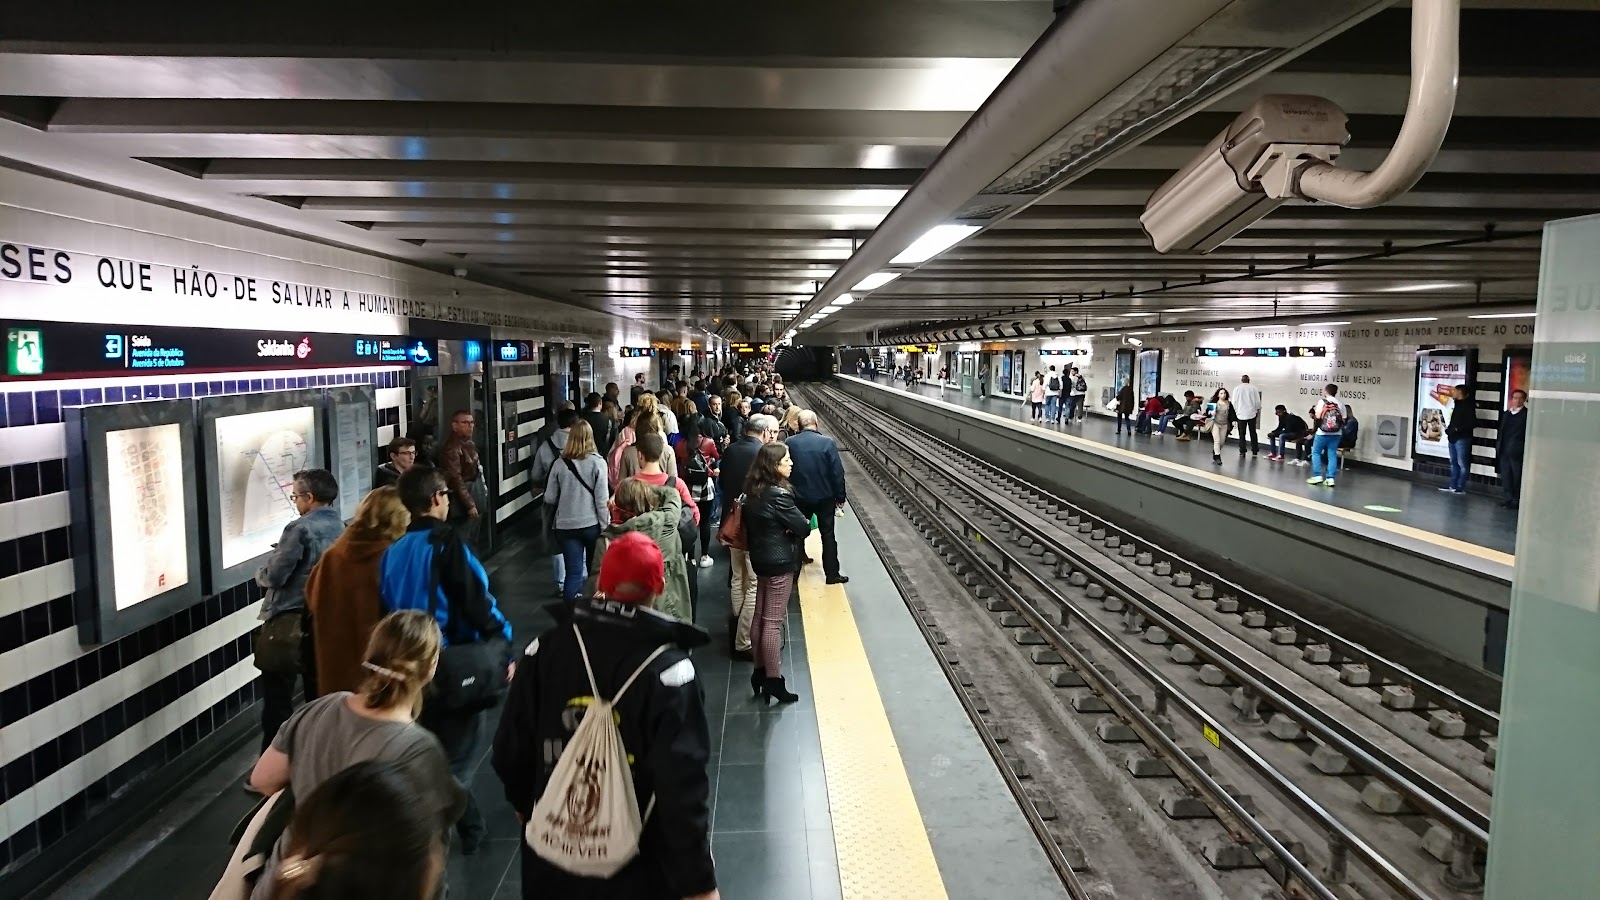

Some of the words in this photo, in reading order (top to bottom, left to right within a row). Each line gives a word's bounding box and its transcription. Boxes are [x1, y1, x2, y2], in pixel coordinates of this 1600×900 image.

[0, 243, 72, 284] SES
[97, 257, 153, 292] QUE
[173, 264, 257, 301] HÃO-DE
[271, 281, 332, 309] SALVAR
[342, 291, 351, 311] A
[359, 293, 426, 317] HUMANIDADE
[1322, 330, 1335, 338] NOS
[1374, 328, 1380, 337] O
[1384, 328, 1399, 337] QUE
[1405, 327, 1431, 336] AINDA
[1438, 326, 1486, 335] PERTENCE
[1494, 325, 1507, 335] AO
[257, 339, 295, 357] Saldanha
[1337, 360, 1345, 368] DA
[1350, 360, 1372, 369] NOSSA
[1429, 360, 1459, 372] Carena
[1353, 375, 1381, 385] MELHOR
[1299, 387, 1308, 395] DO
[1311, 388, 1323, 396] QUE
